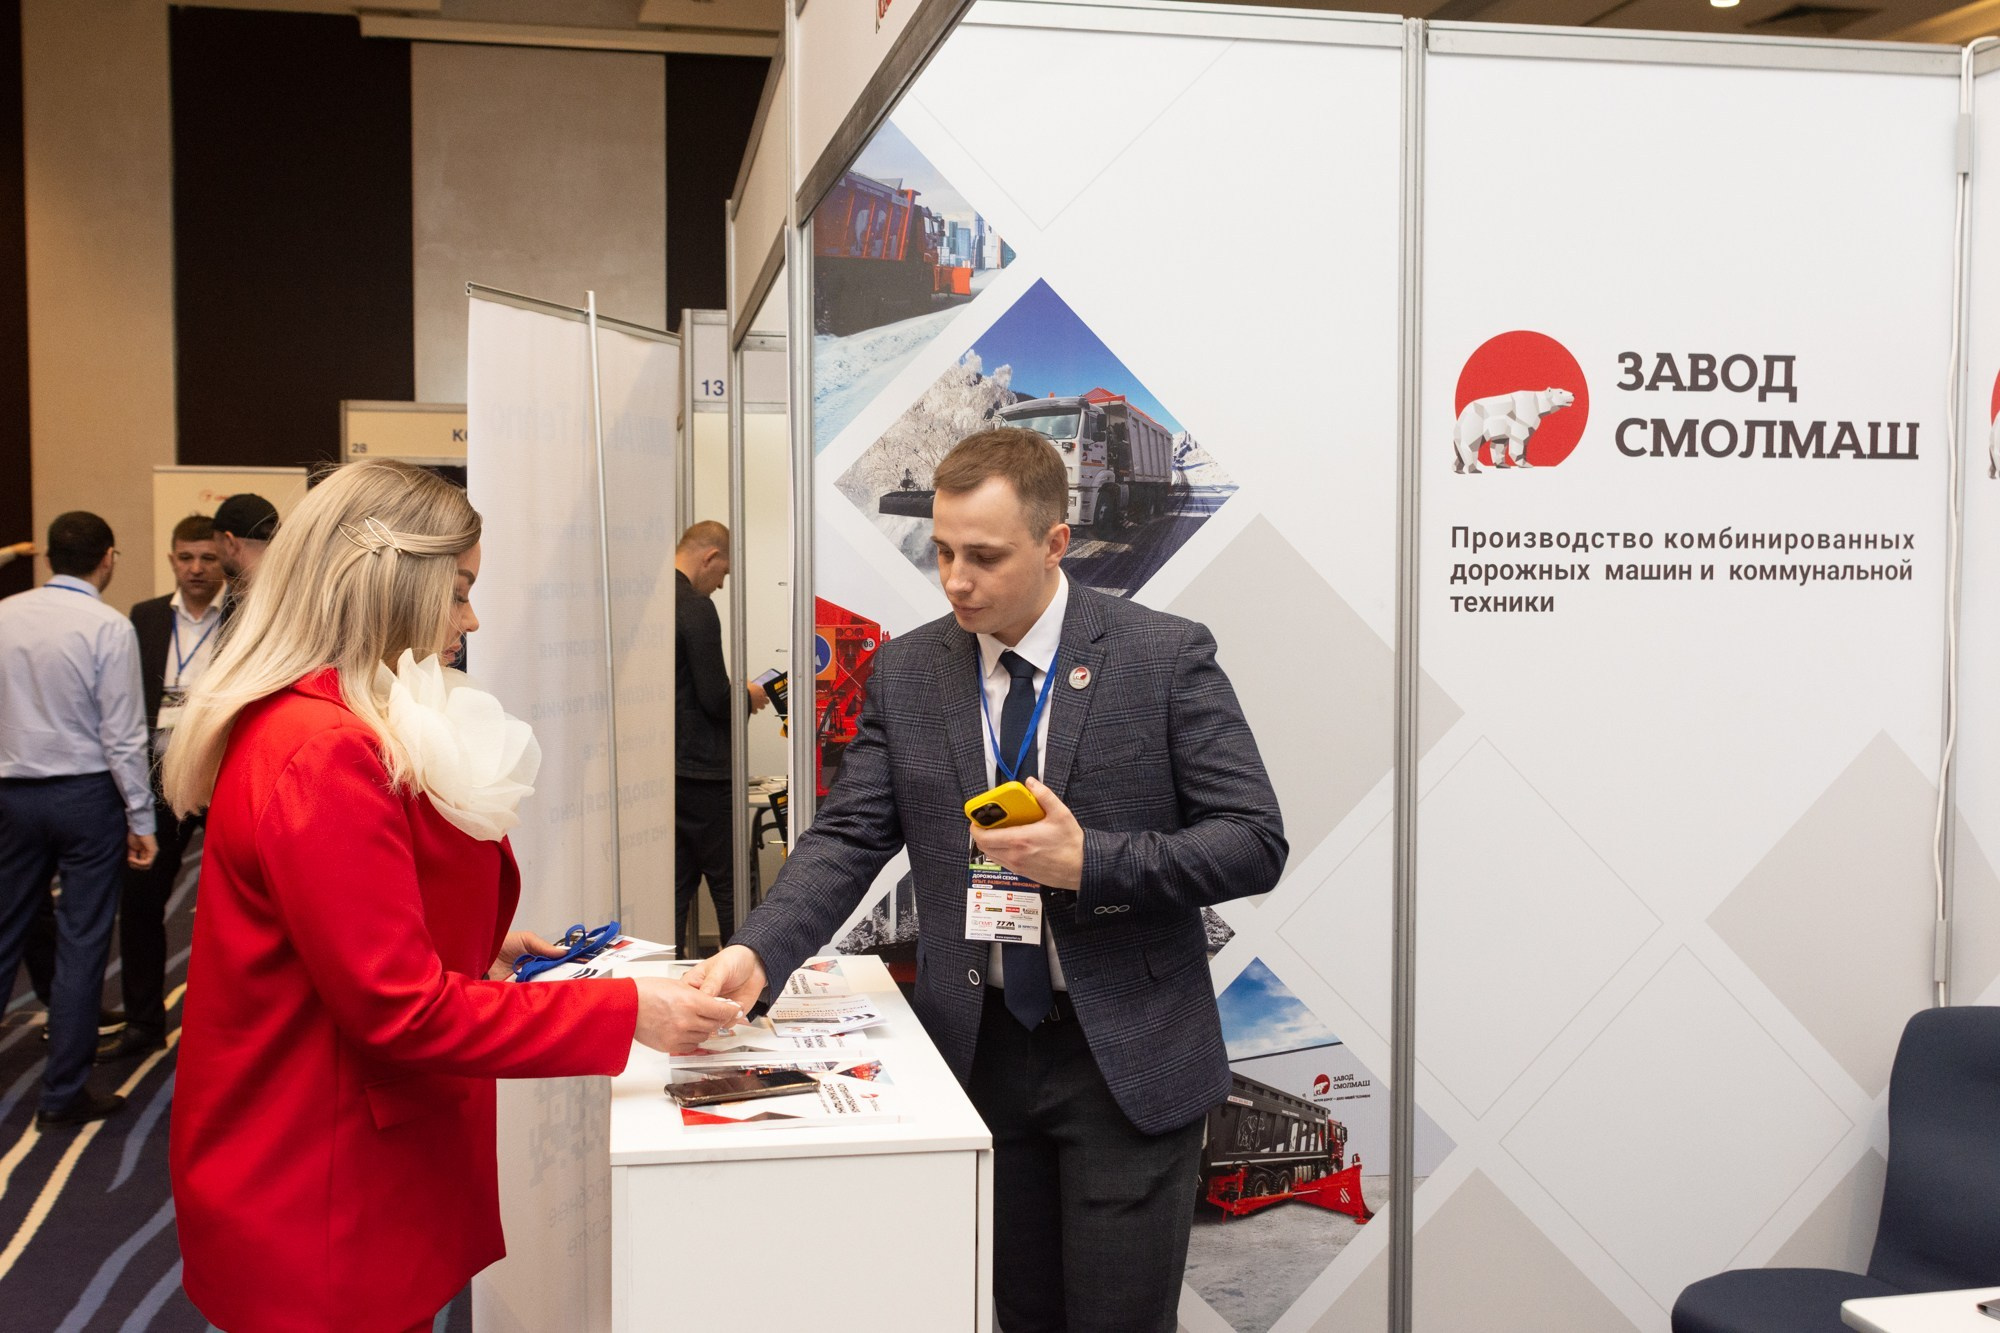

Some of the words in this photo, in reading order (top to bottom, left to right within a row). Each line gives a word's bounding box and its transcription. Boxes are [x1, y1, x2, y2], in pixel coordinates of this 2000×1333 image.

[1615, 351, 1798, 403] ЗАВОД
[701, 379, 725, 397] 13
[352, 443, 368, 454] 28
[1614, 417, 1920, 461] СМОЛМАШ
[1450, 525, 1654, 553] Производство
[1663, 525, 1916, 553] комбинированных
[1449, 560, 1591, 586] дорожных
[1604, 562, 1693, 582] машин
[1699, 562, 1716, 582] и
[1728, 558, 1914, 586] коммунальной
[1450, 593, 1555, 613] техники
[1333, 1074, 1354, 1082] ЗАВОД
[1333, 1080, 1370, 1090] СМОЛМАШ
